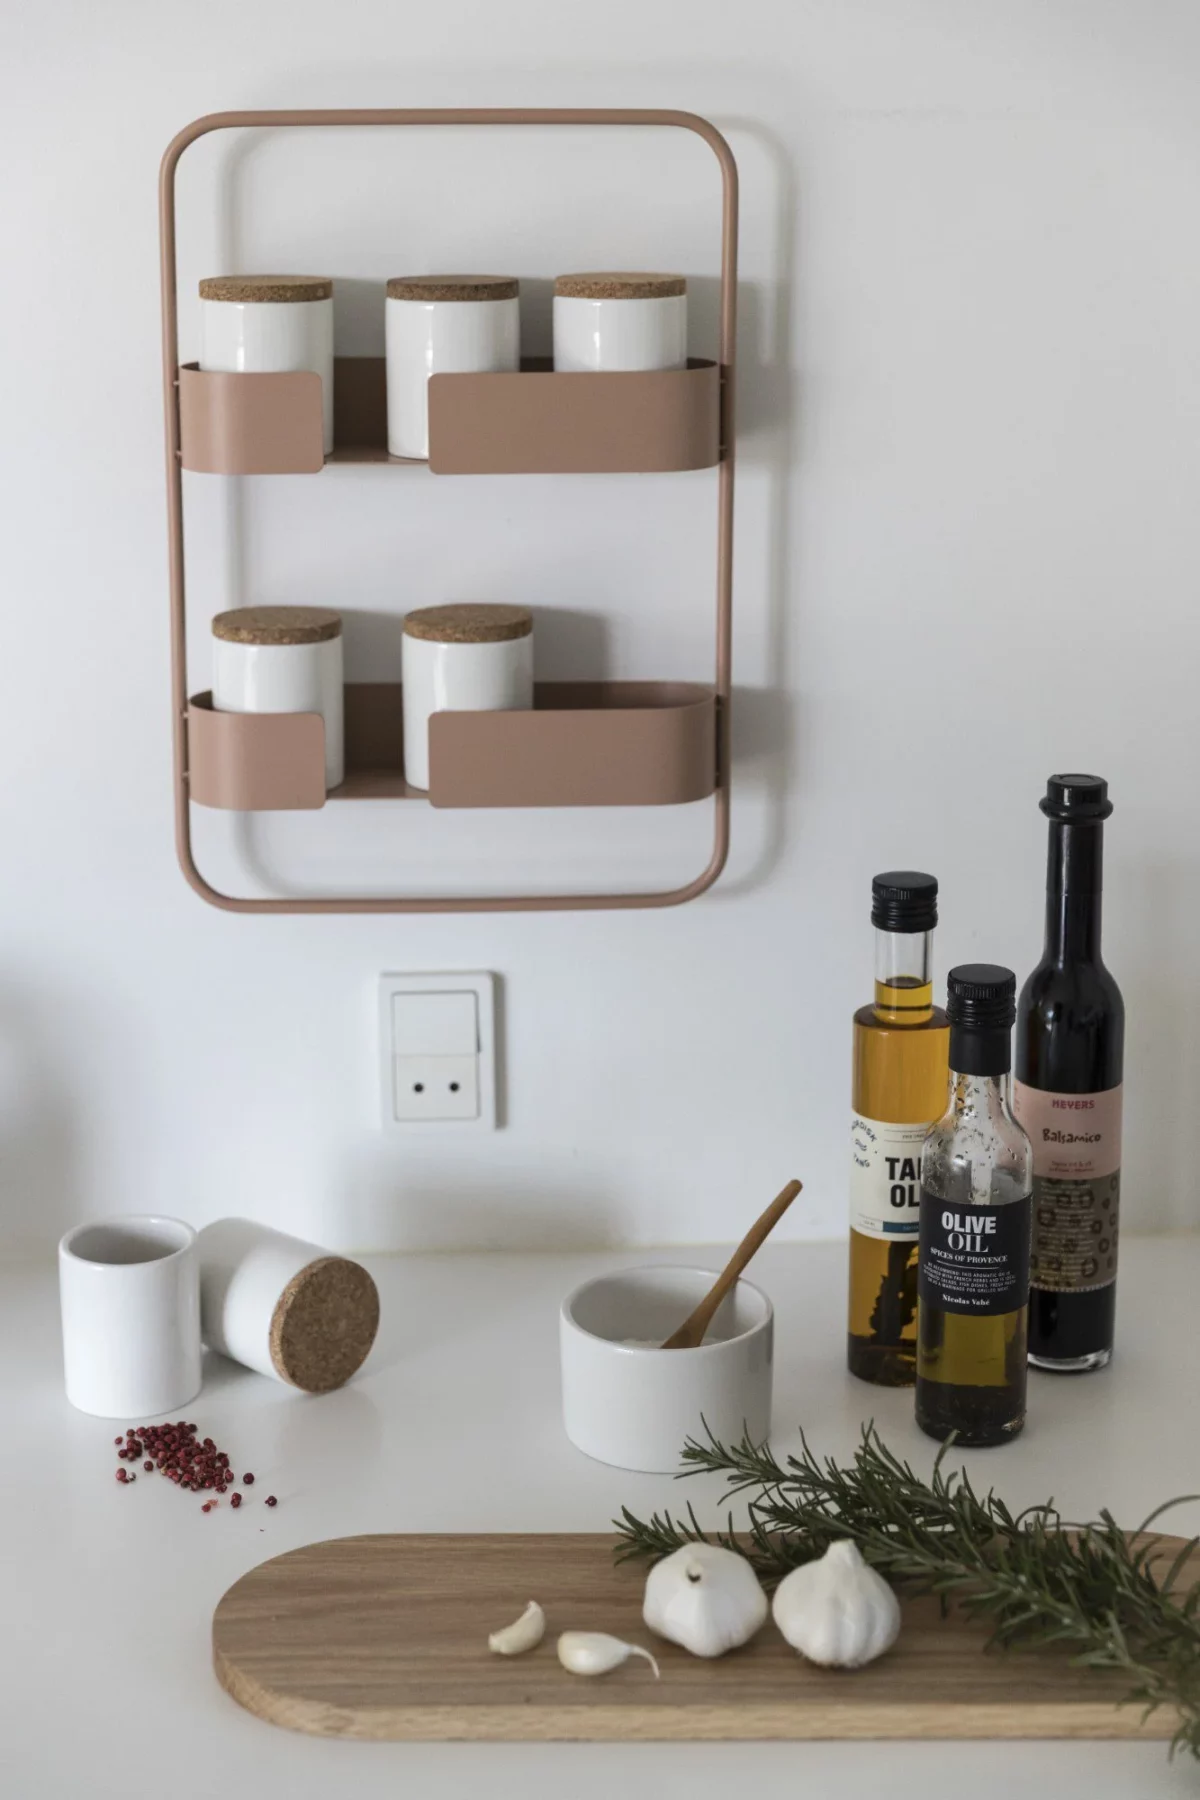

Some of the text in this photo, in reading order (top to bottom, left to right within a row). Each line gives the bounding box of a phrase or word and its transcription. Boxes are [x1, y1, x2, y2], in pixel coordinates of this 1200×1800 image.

[1042, 1127, 1102, 1144] Balsamico
[941, 1210, 997, 1234] OLIVE
[947, 1232, 989, 1253] OIL
[930, 1246, 953, 1260] SPICES
[966, 1255, 1008, 1264] PROVENCE
[942, 1293, 990, 1306] Nicolas Vahé
